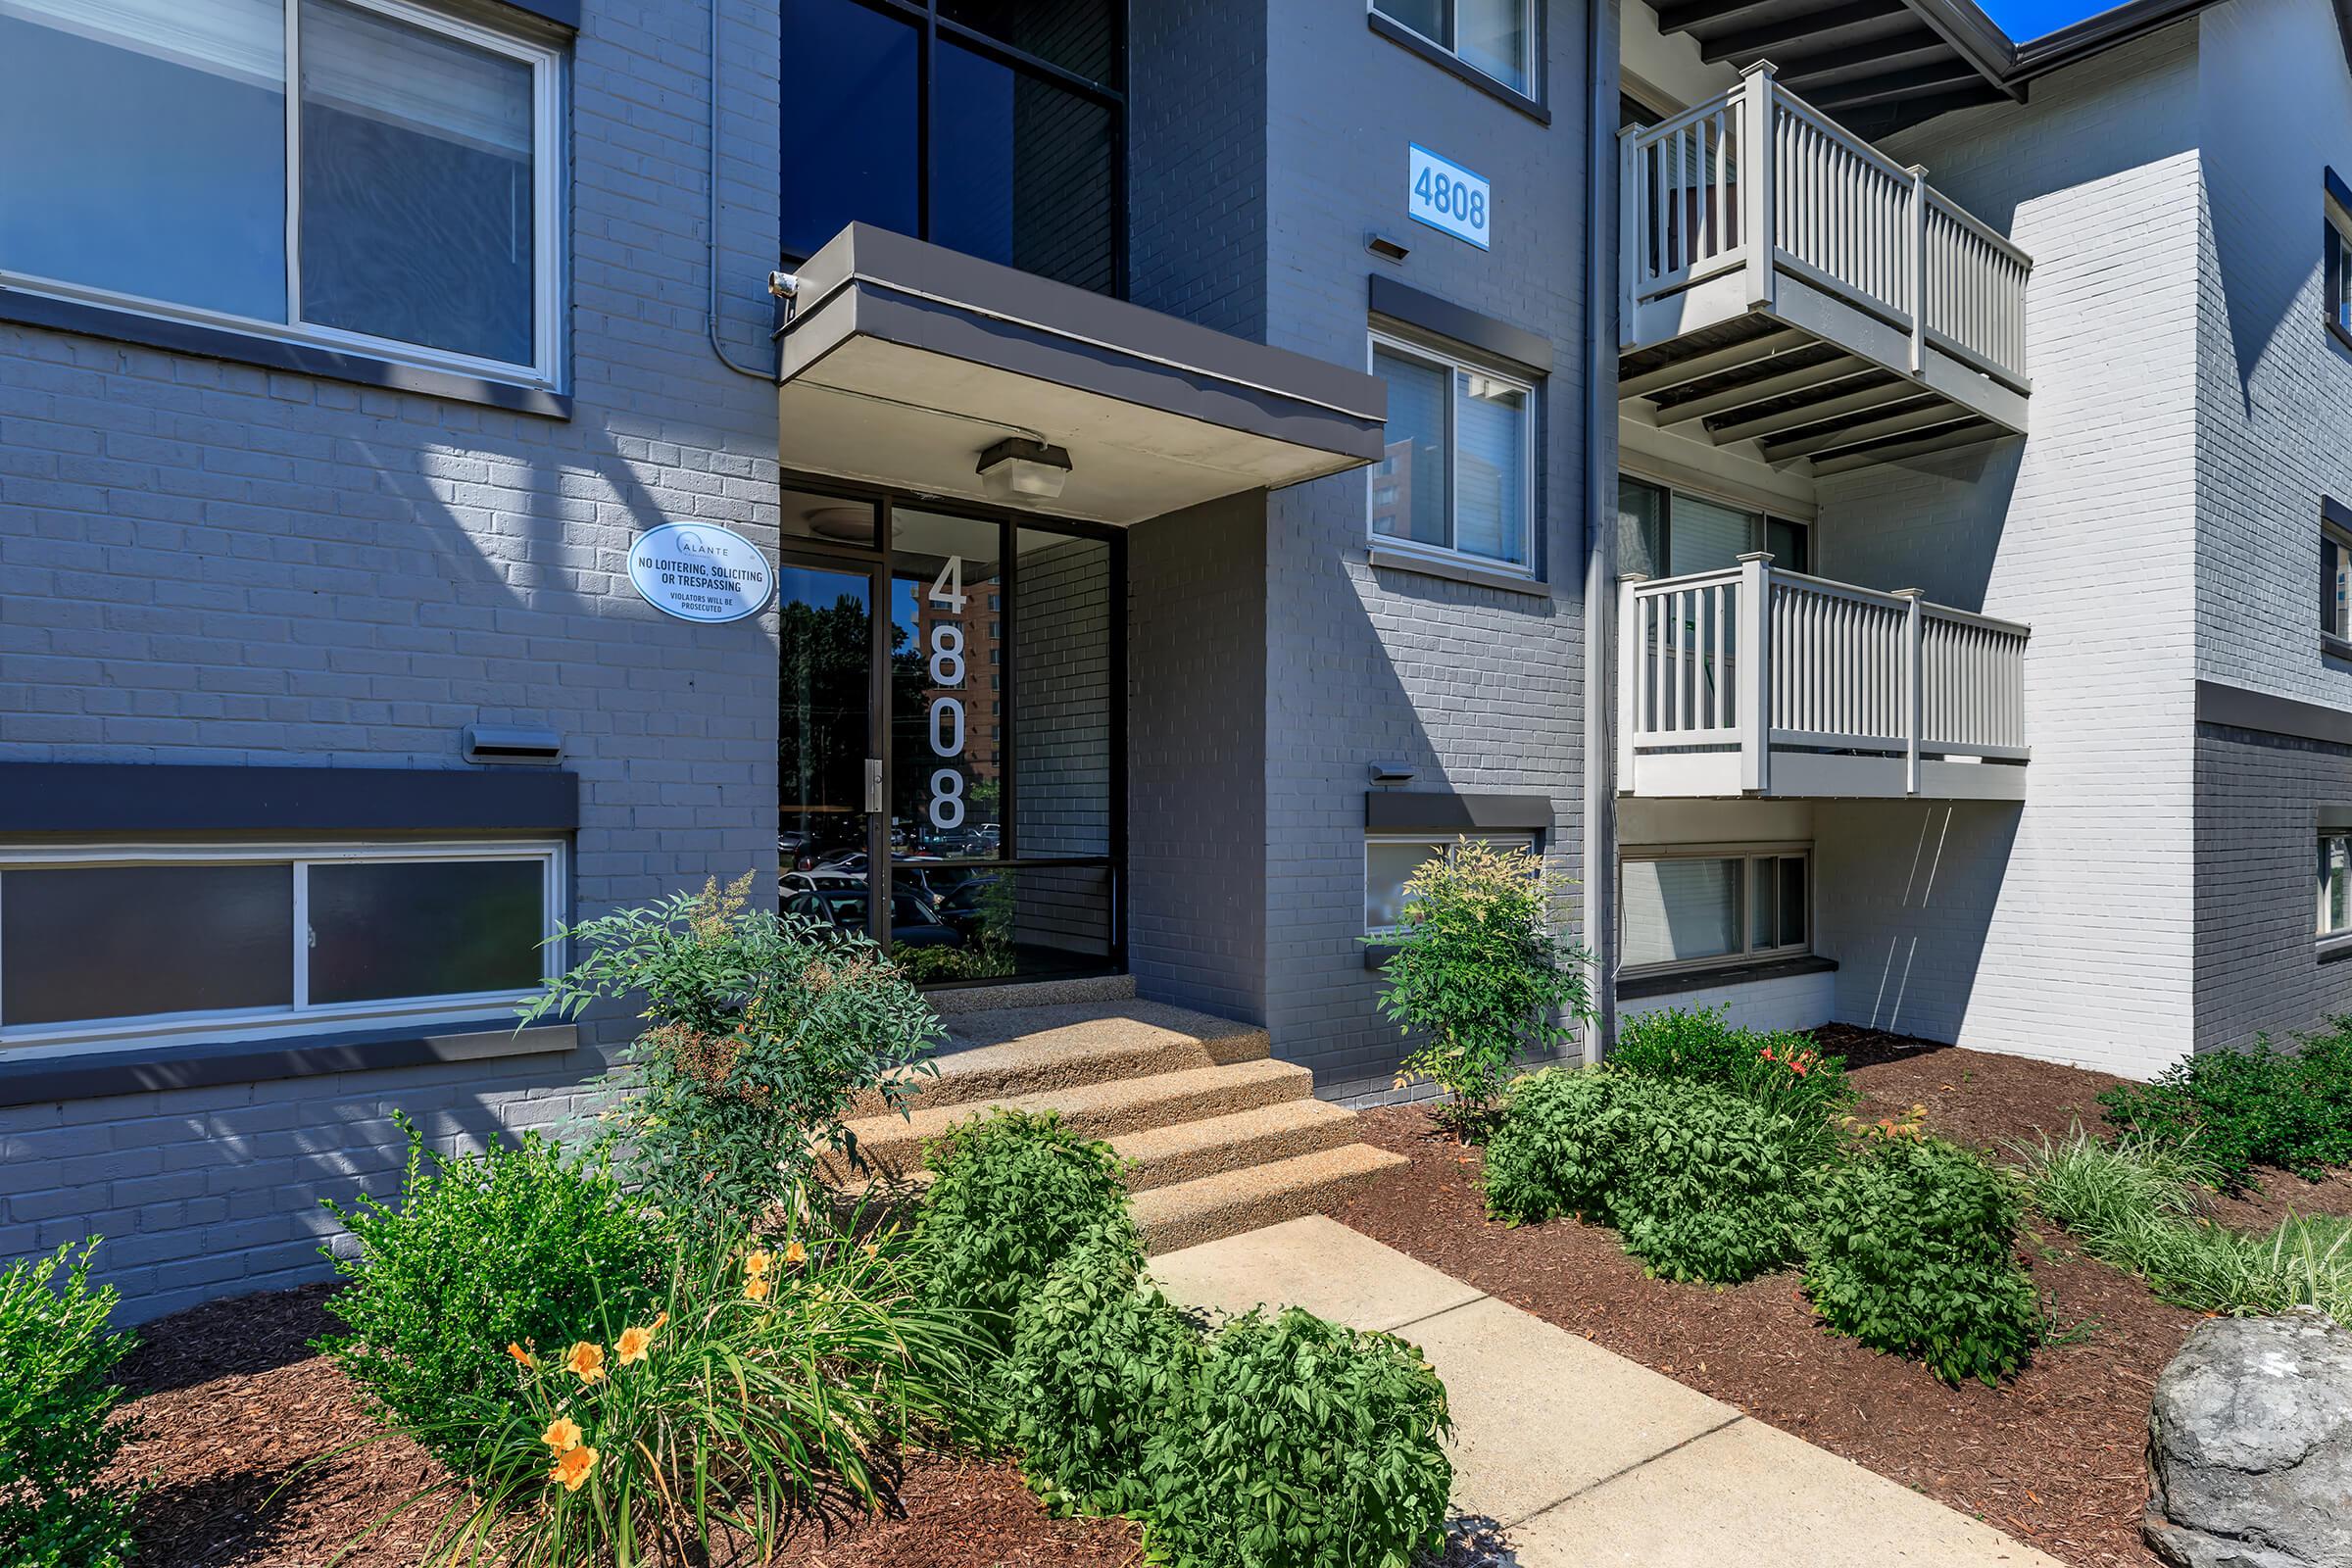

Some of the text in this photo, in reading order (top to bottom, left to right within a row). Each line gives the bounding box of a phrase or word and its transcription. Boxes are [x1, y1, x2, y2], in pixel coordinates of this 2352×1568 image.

[1414, 166, 1486, 229] 4808
[683, 543, 729, 557] ALANTE
[638, 557, 762, 582] NO LOITERING, SOLICITING
[662, 572, 742, 593] OR TRESPASSING
[669, 592, 706, 603] VIOLATORS
[707, 596, 723, 605] WILL
[681, 602, 722, 612] PROSECUTED
[928, 555, 967, 829] 4808
